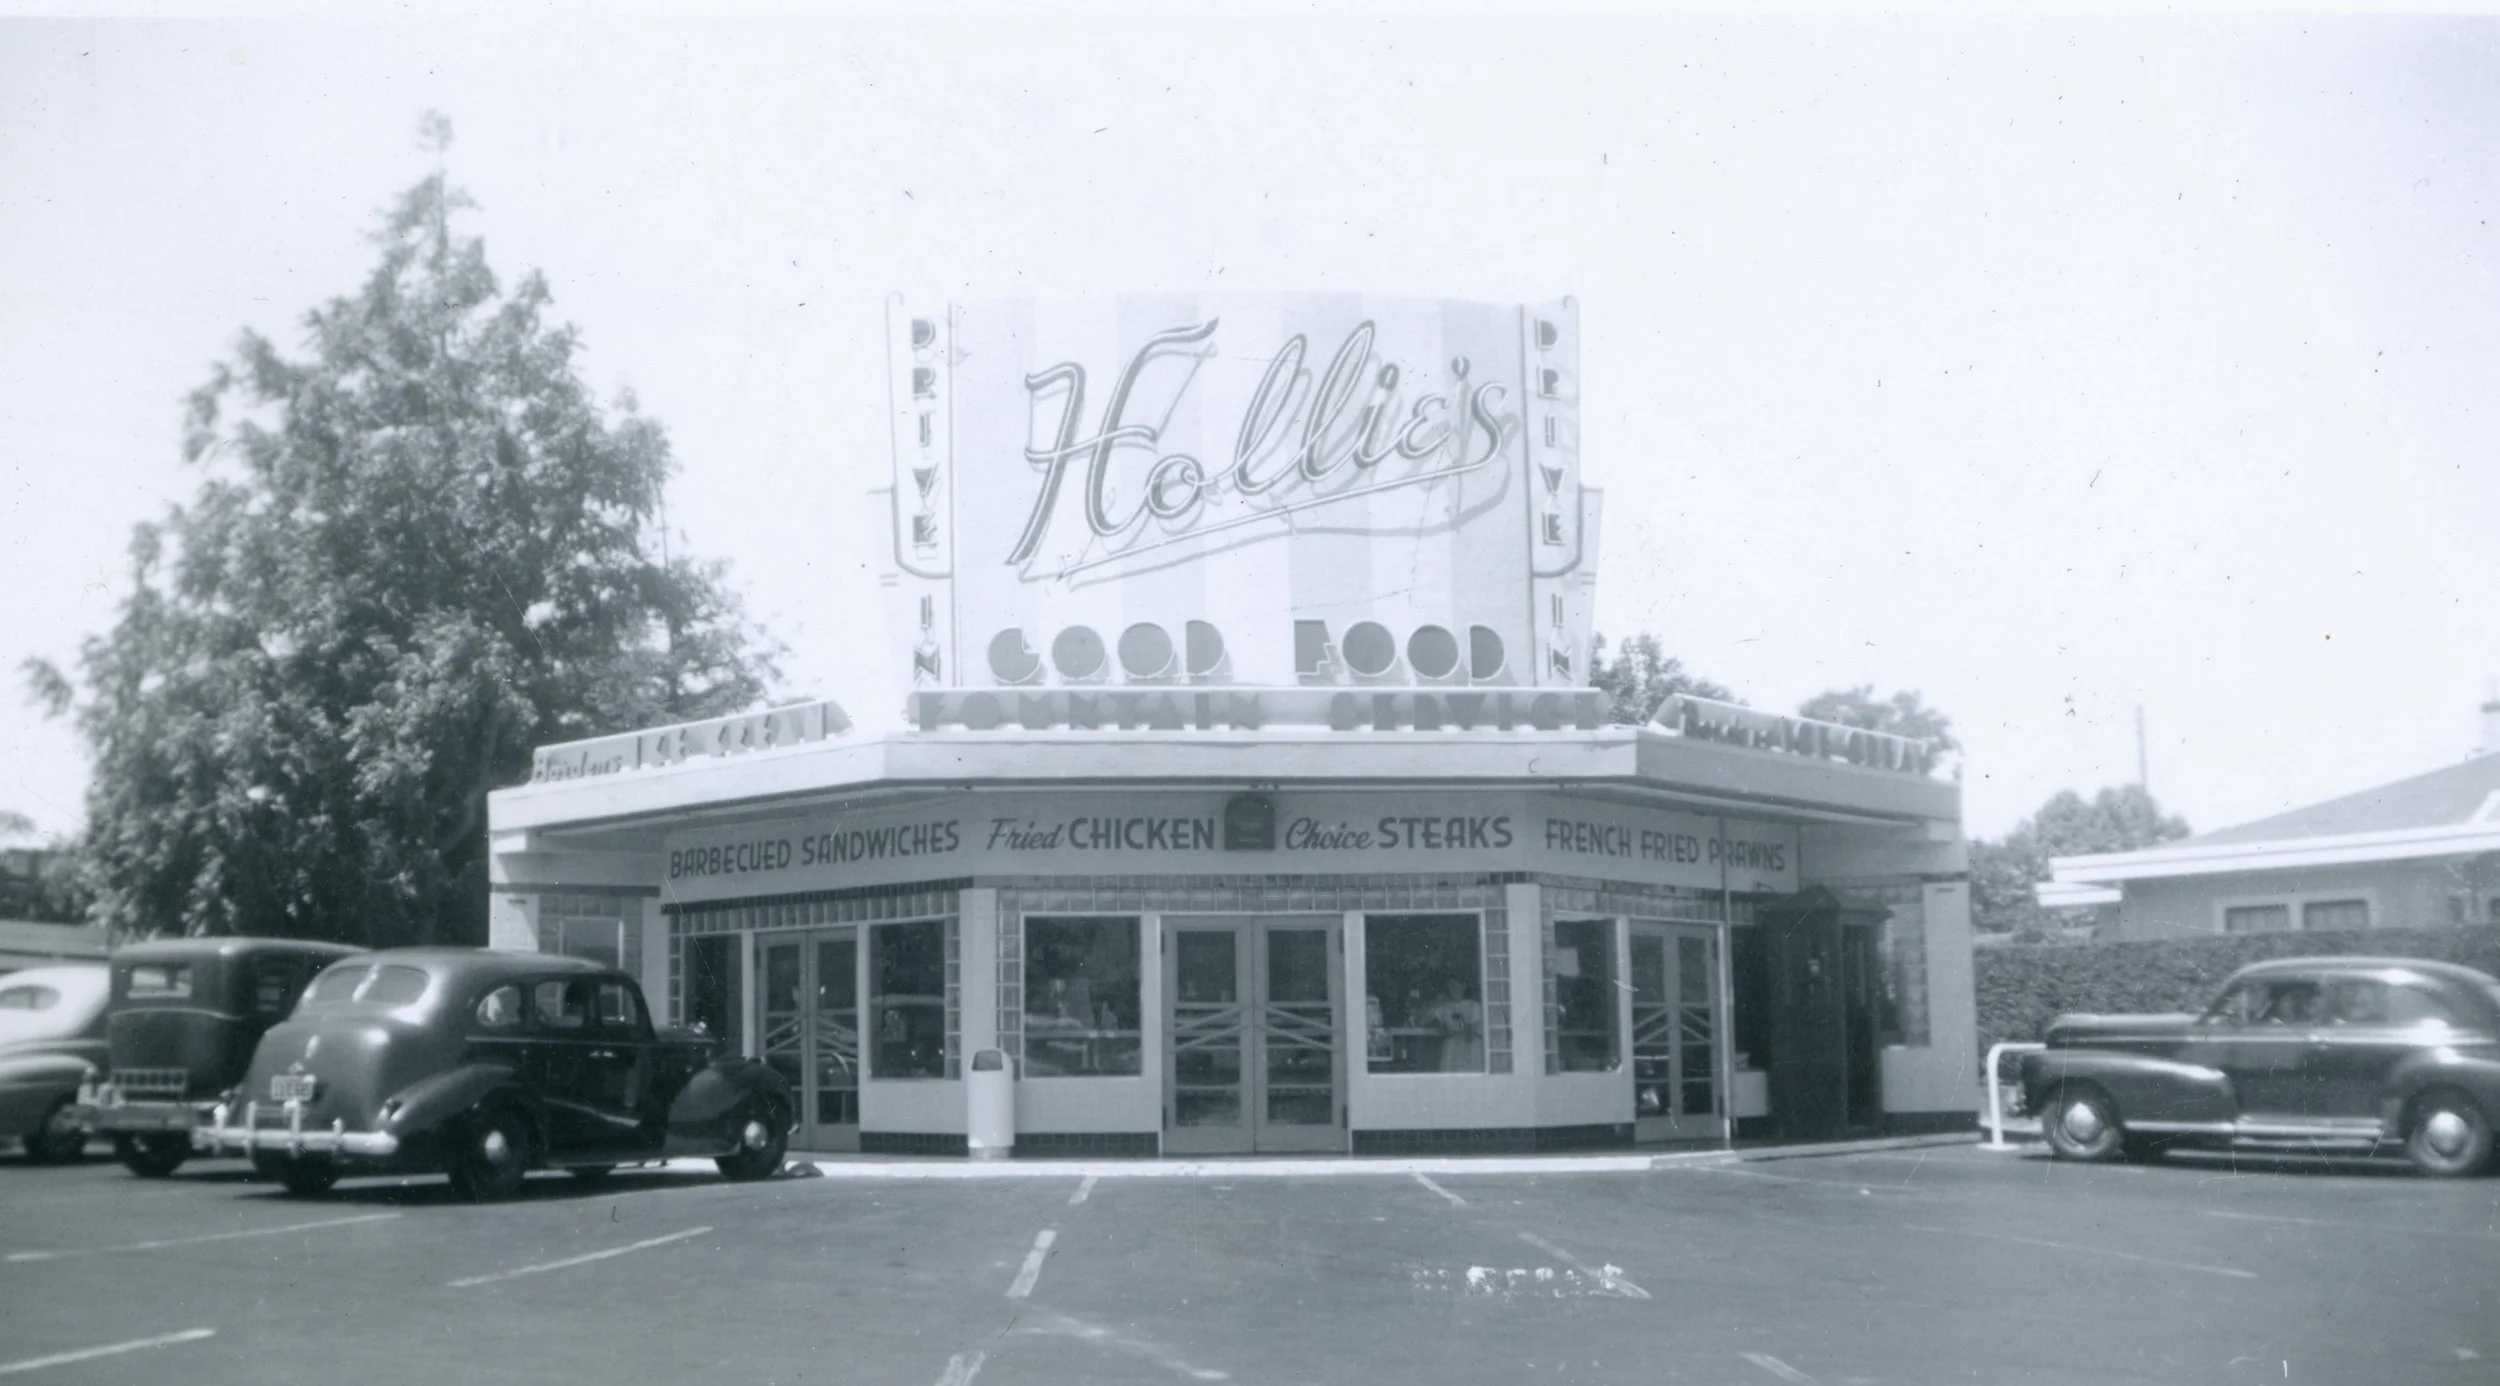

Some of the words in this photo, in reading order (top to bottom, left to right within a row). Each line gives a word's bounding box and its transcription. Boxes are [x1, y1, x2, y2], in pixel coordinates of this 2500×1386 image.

[910, 317, 938, 548] DRIVE
[1005, 317, 1508, 581] Hollie's
[1534, 317, 1560, 546] DRIVE
[1547, 592, 1573, 682] IN
[913, 594, 941, 682] IN
[987, 620, 1226, 684] GOOD
[1293, 620, 1505, 682] FOOD
[670, 838, 791, 879] BARBECUED
[802, 819, 960, 867] SANDWICHES
[986, 818, 1066, 851] Fried
[1069, 818, 1215, 850] CHICKEN
[1285, 817, 1375, 850] Choice
[1378, 817, 1514, 850] STEAKS
[1546, 818, 1632, 859] FRENCH
[1641, 830, 1698, 865] FRIED
[1709, 837, 1785, 872] PRAWNS
